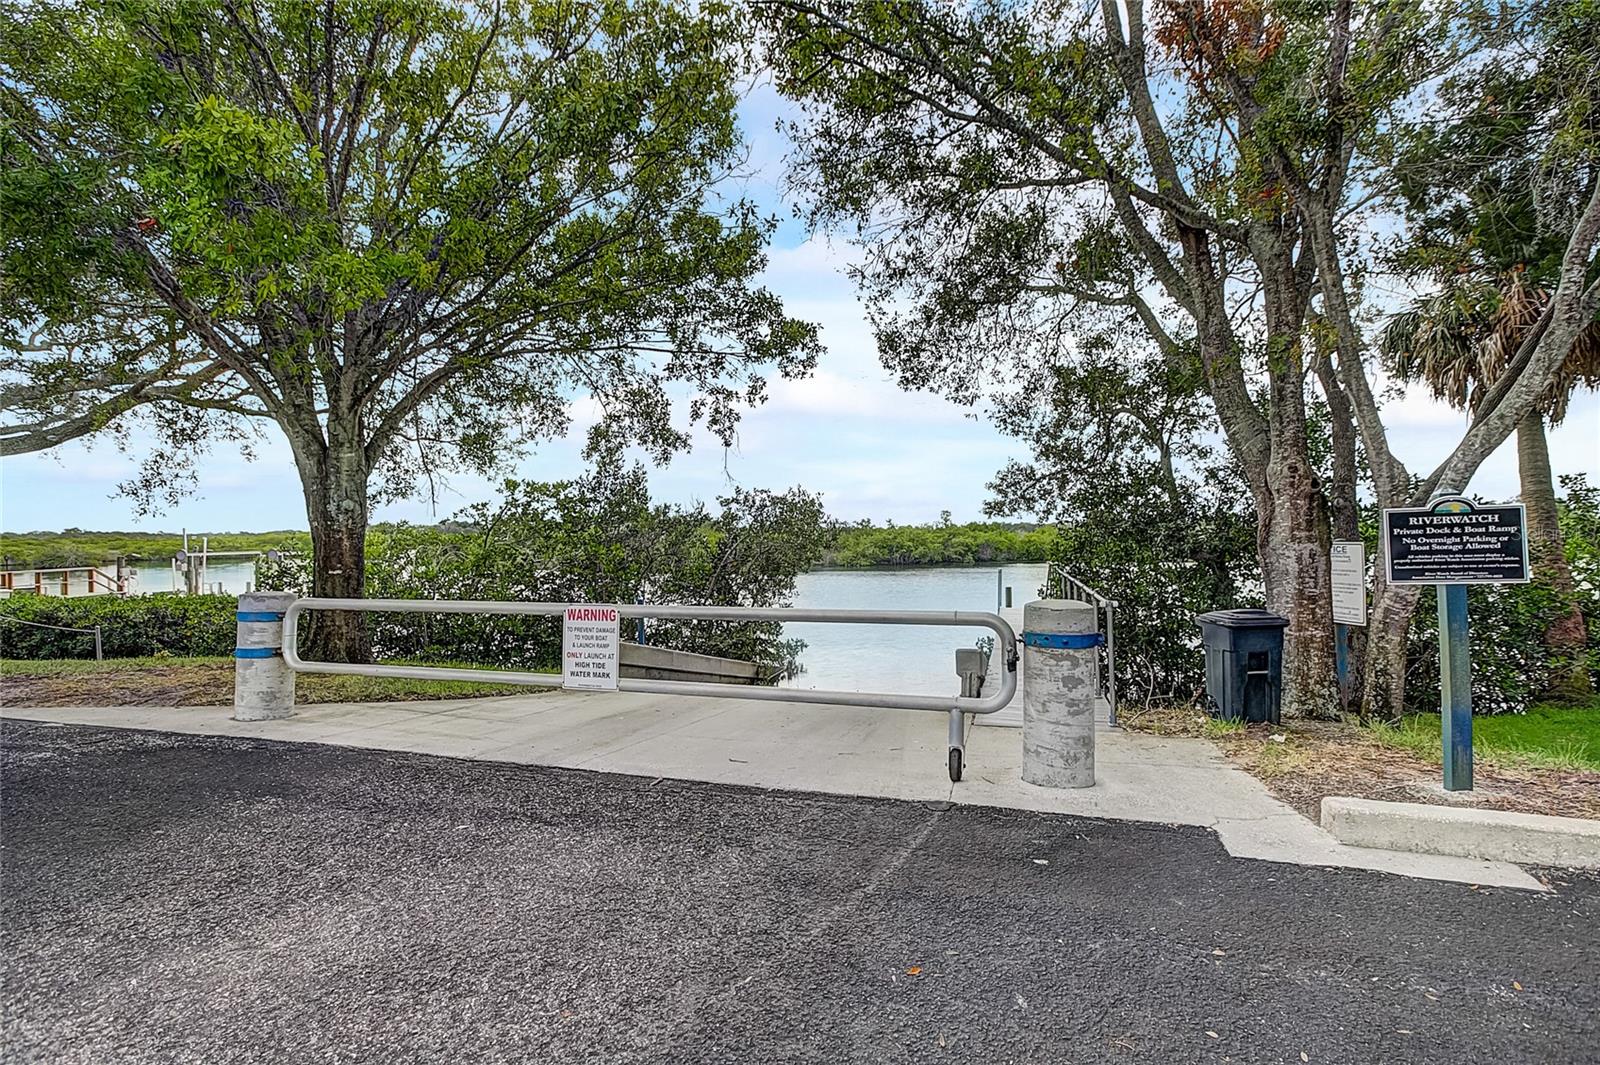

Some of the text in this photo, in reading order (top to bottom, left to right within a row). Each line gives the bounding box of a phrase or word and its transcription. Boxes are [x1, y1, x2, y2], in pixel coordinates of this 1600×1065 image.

[1408, 514, 1500, 525] RIVERWATCH
[1488, 525, 1517, 534] Ramp
[1417, 536, 1461, 544] Overnight
[1462, 535, 1498, 543] Parking
[1431, 543, 1463, 551] Storage
[1464, 542, 1501, 550] Allowed
[567, 608, 616, 622] WARNING
[566, 651, 583, 659] ONLY
